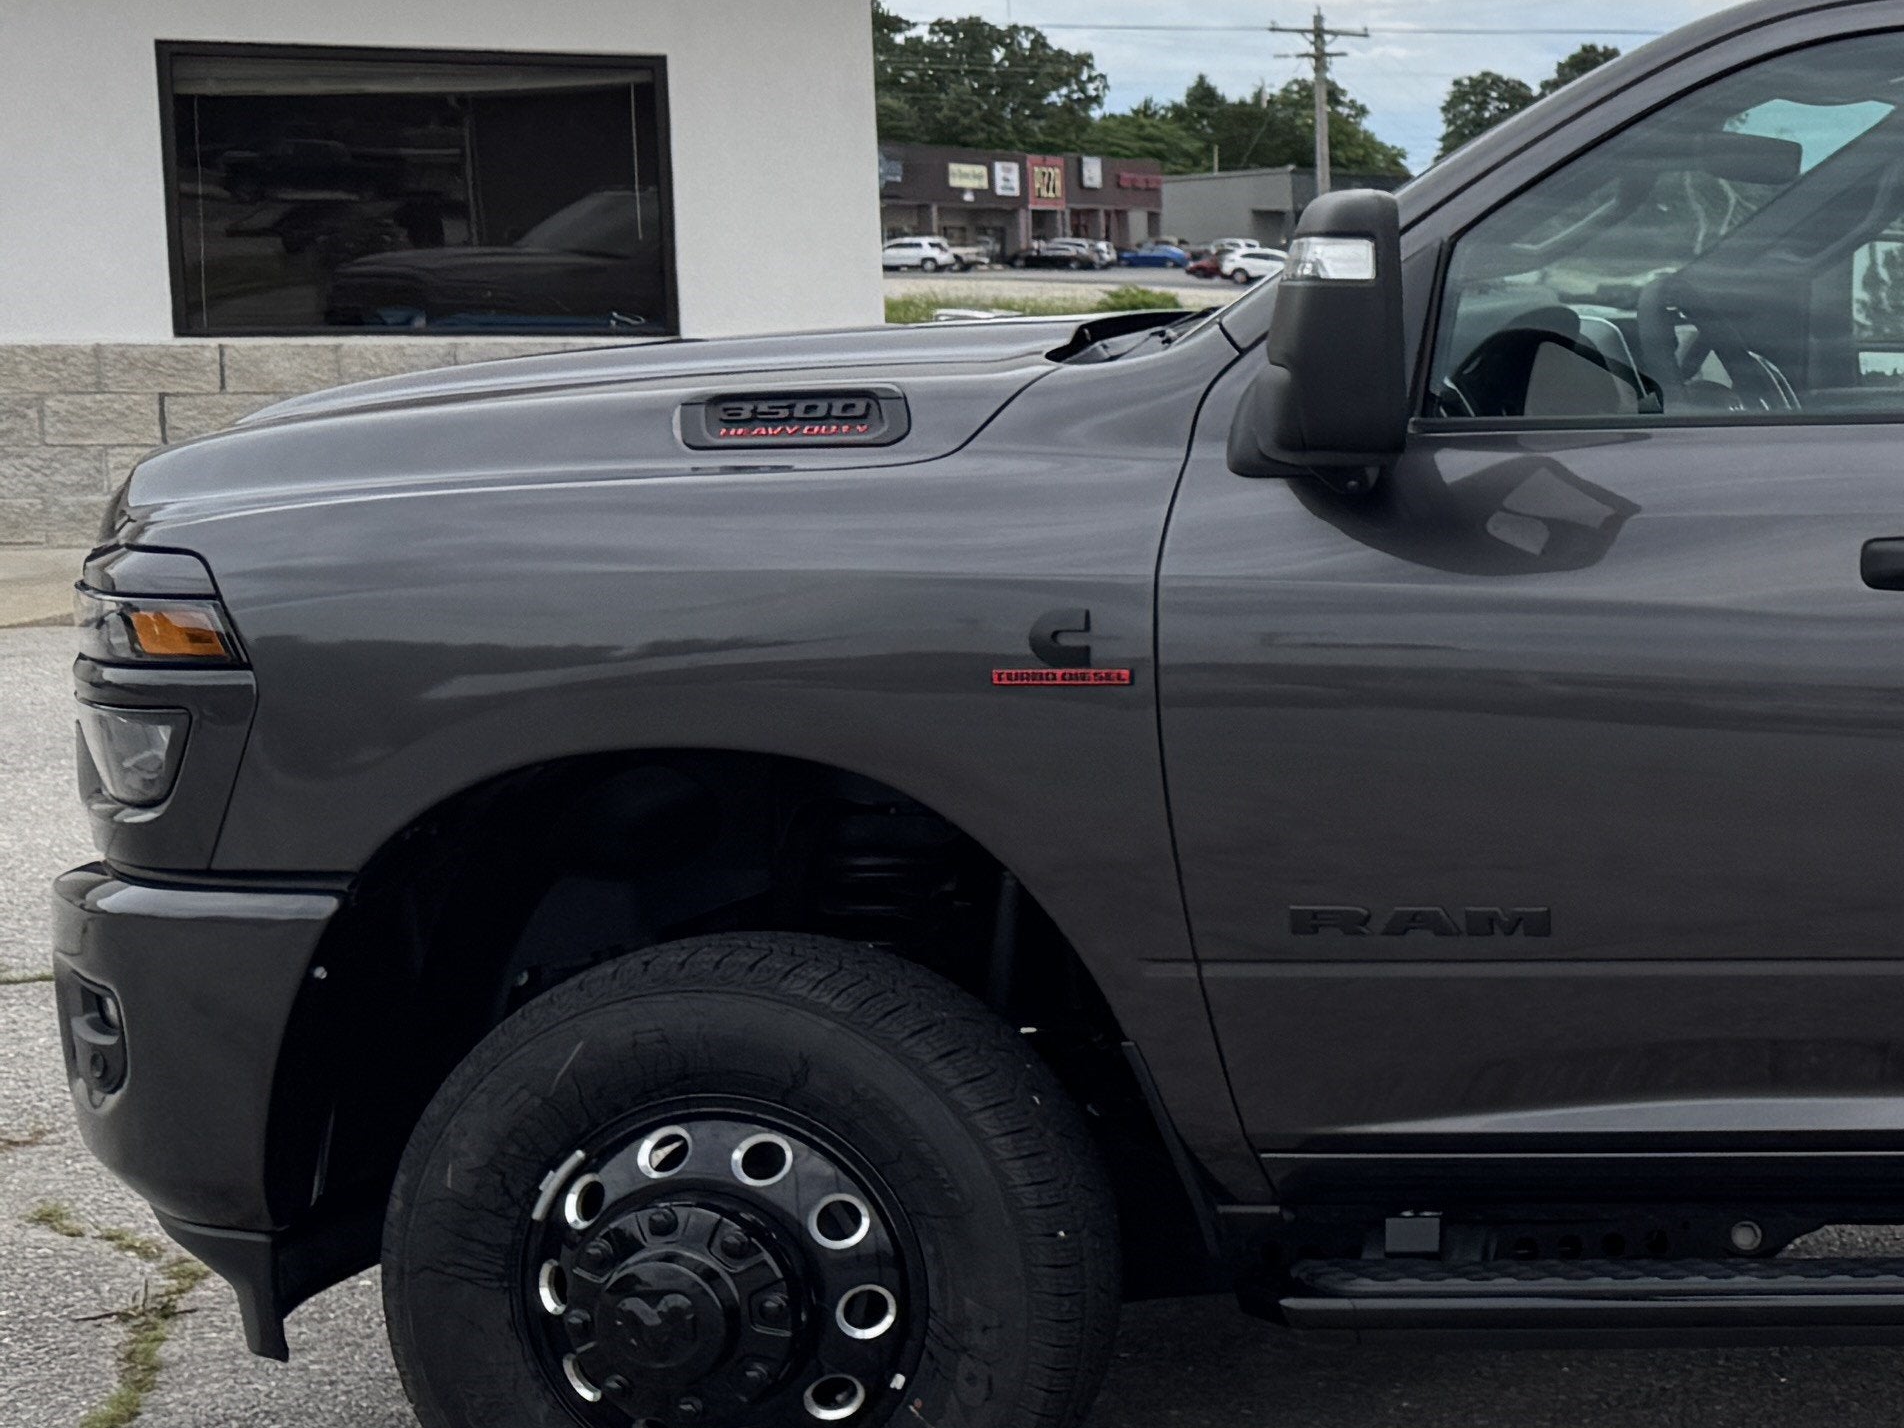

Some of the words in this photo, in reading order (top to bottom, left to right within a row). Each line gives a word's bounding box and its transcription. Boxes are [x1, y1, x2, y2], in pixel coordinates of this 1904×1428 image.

[719, 398, 873, 422] 3500
[719, 424, 800, 438] HEAVY
[802, 423, 871, 436] DUTY
[1289, 905, 1552, 937] RAM
